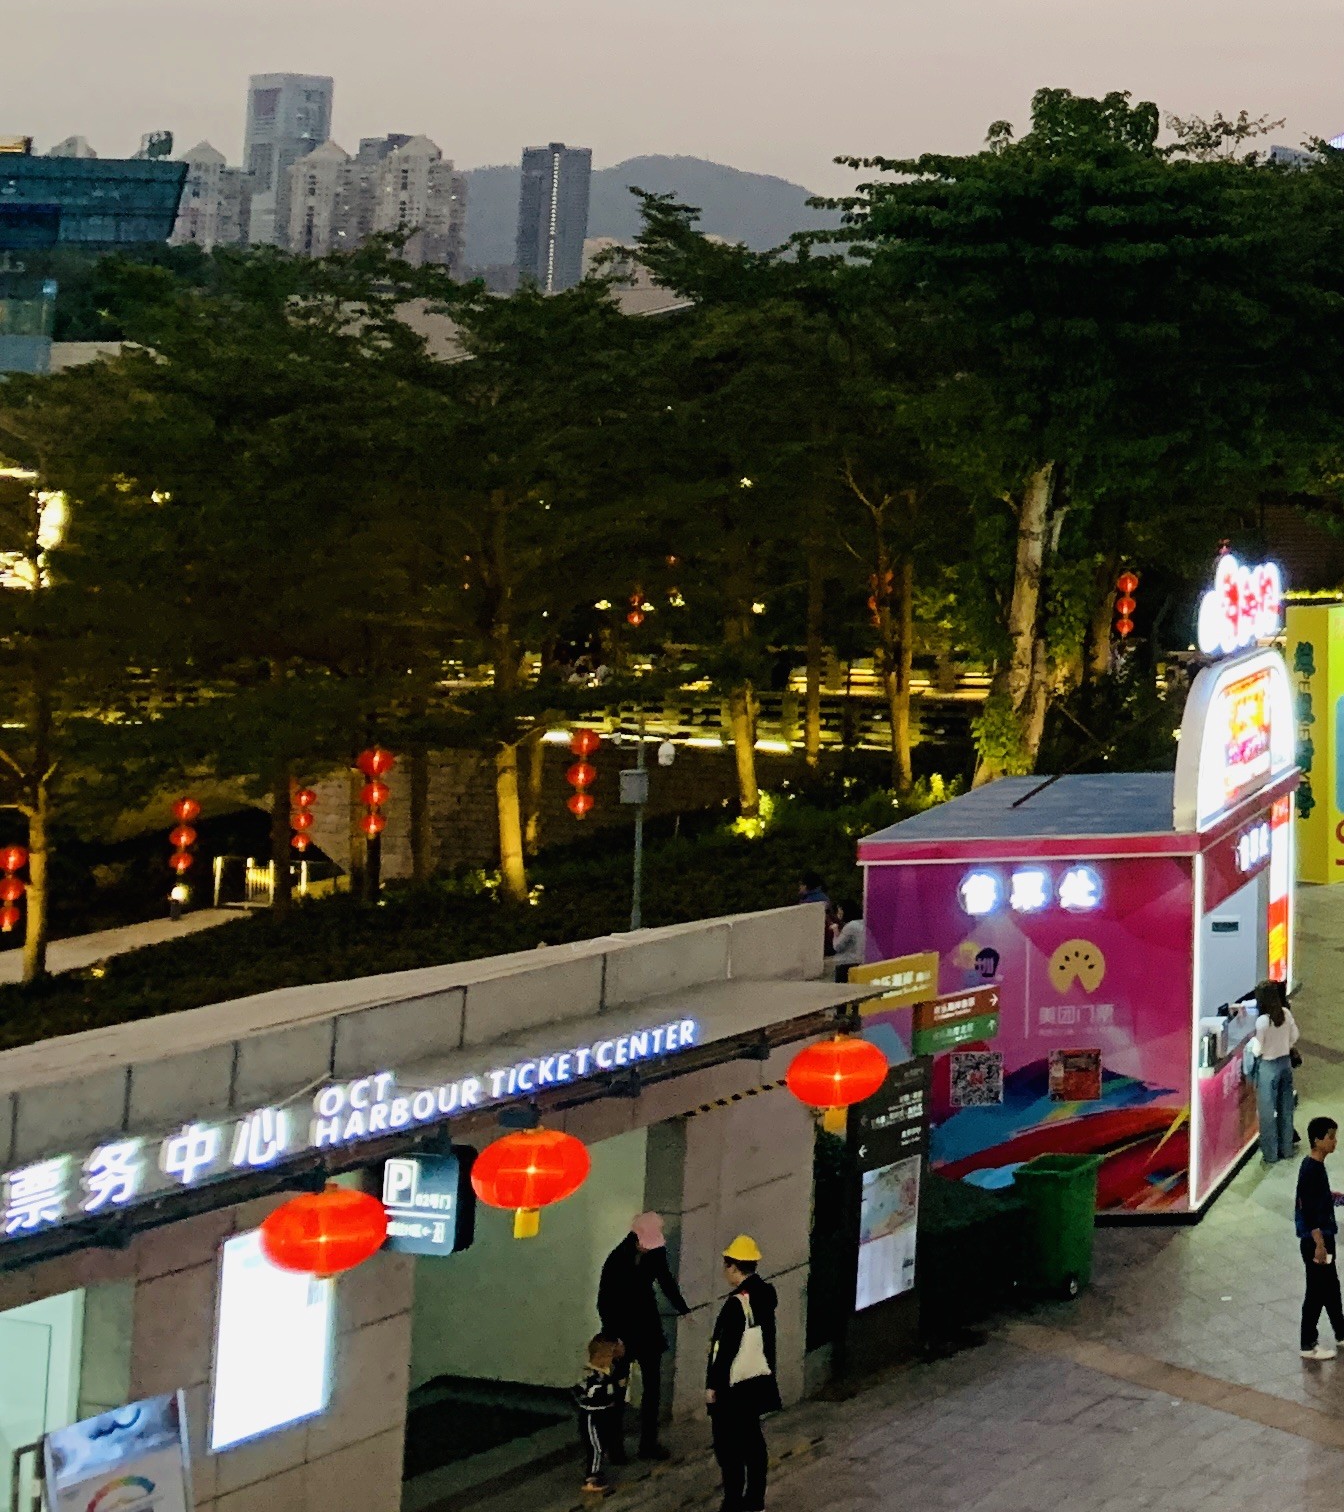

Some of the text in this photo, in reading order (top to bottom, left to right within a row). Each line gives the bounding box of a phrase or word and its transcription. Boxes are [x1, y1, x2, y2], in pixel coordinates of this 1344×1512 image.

[313, 1018, 698, 1147] HARBOUR TICKET CENTER
[317, 1072, 394, 1117] OCT
[4, 1107, 290, 1236] 票务中心
[387, 1162, 414, 1203] P
